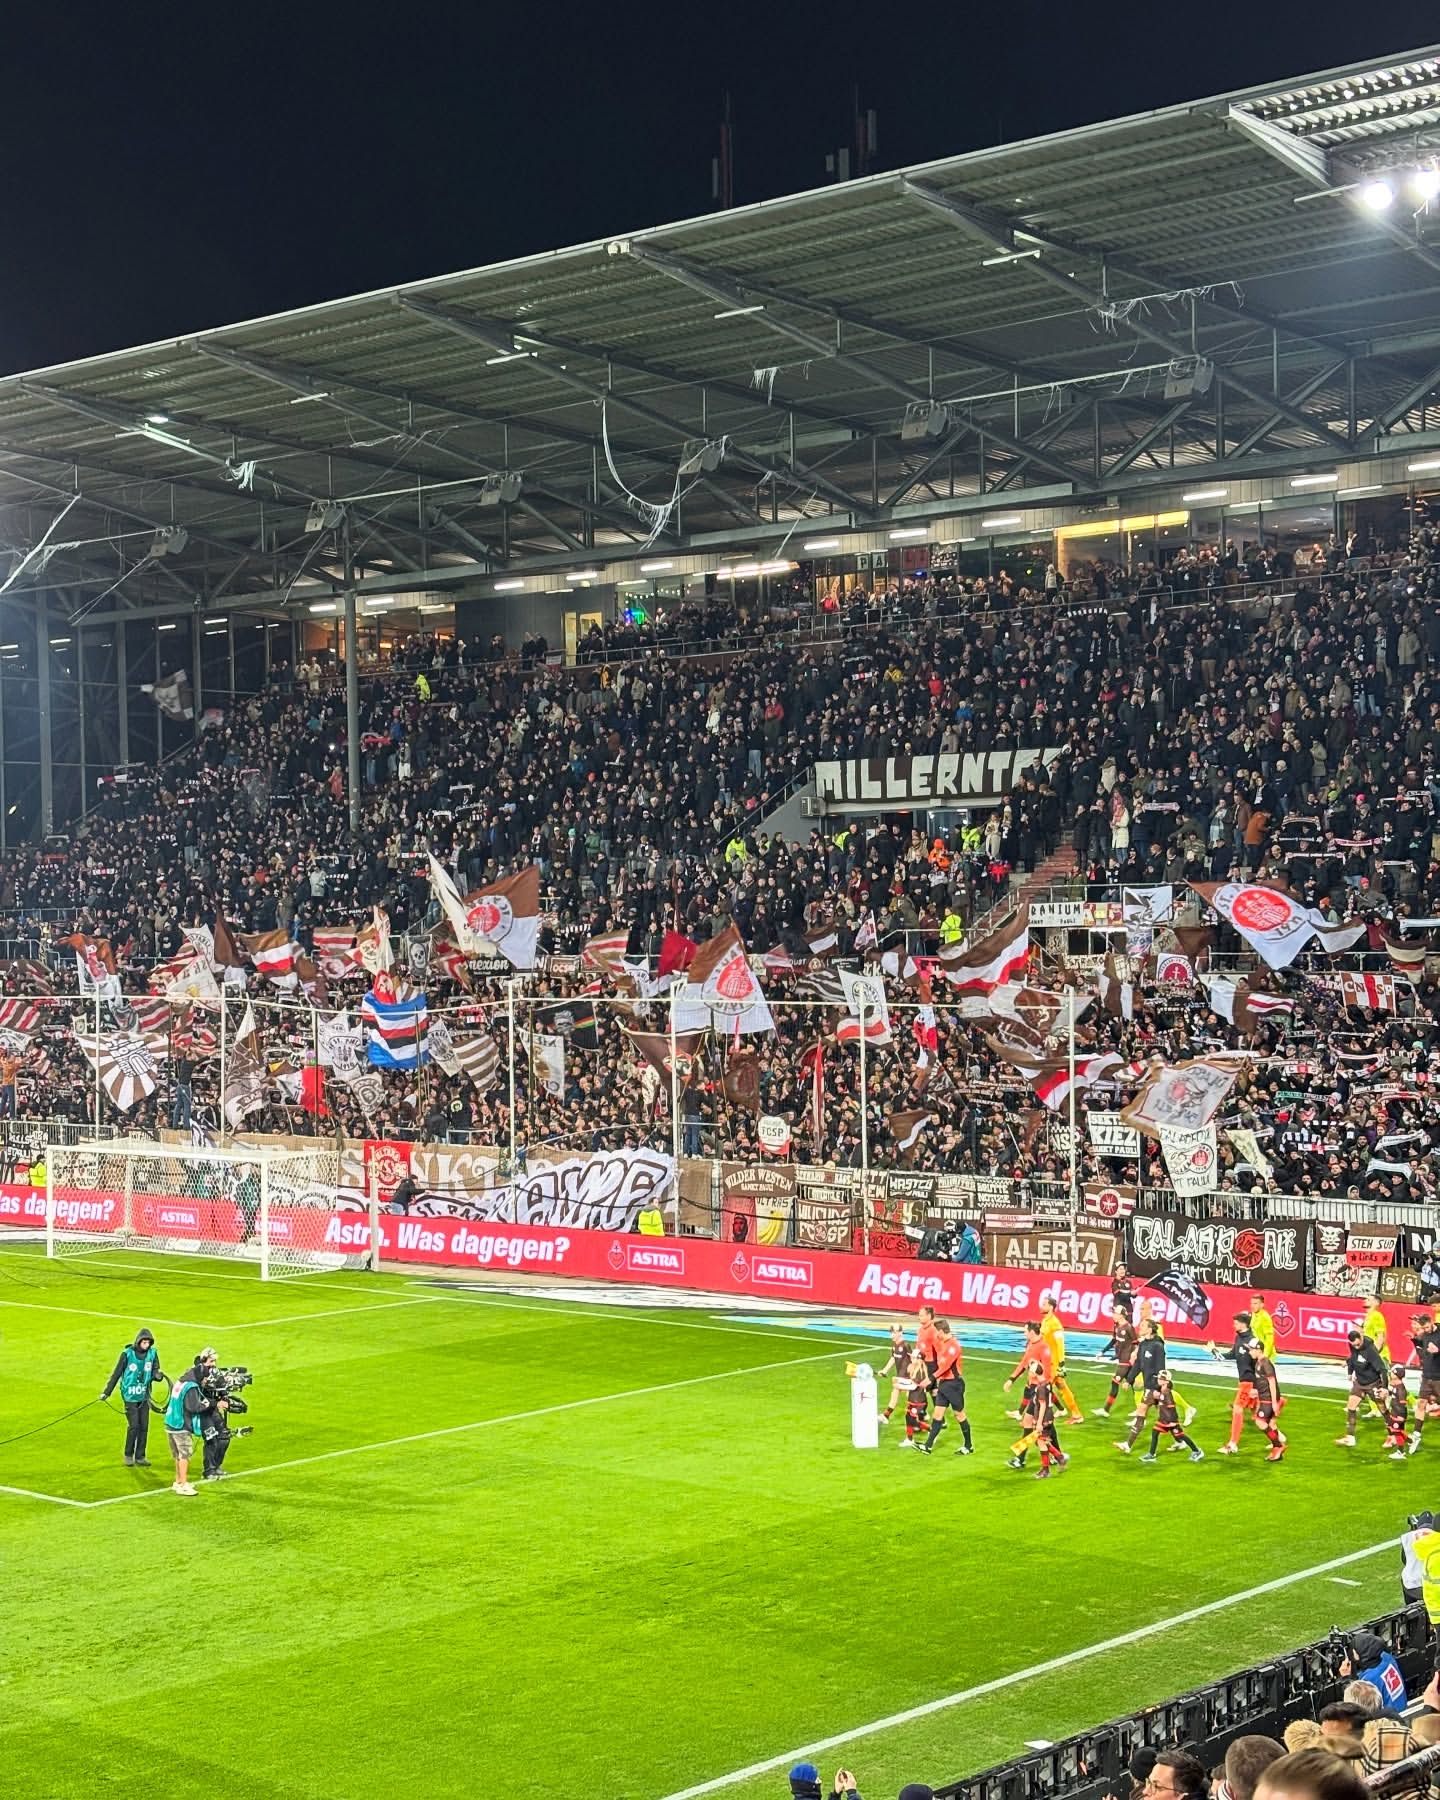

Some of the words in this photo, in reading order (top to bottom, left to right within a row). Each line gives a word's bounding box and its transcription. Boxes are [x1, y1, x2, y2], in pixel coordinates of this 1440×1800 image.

[725, 1168, 755, 1190] WILDER
[758, 1168, 793, 1192] WESTEN
[160, 1212, 195, 1225] ASTRA
[398, 1223, 445, 1253] Was
[451, 1228, 570, 1265] dagegen?
[1005, 1238, 1099, 1263] ALERTA
[632, 1250, 679, 1268] ASTRA
[757, 1263, 808, 1282] ASTRA
[857, 1263, 951, 1301] Astra.
[961, 1271, 1031, 1309] Was
